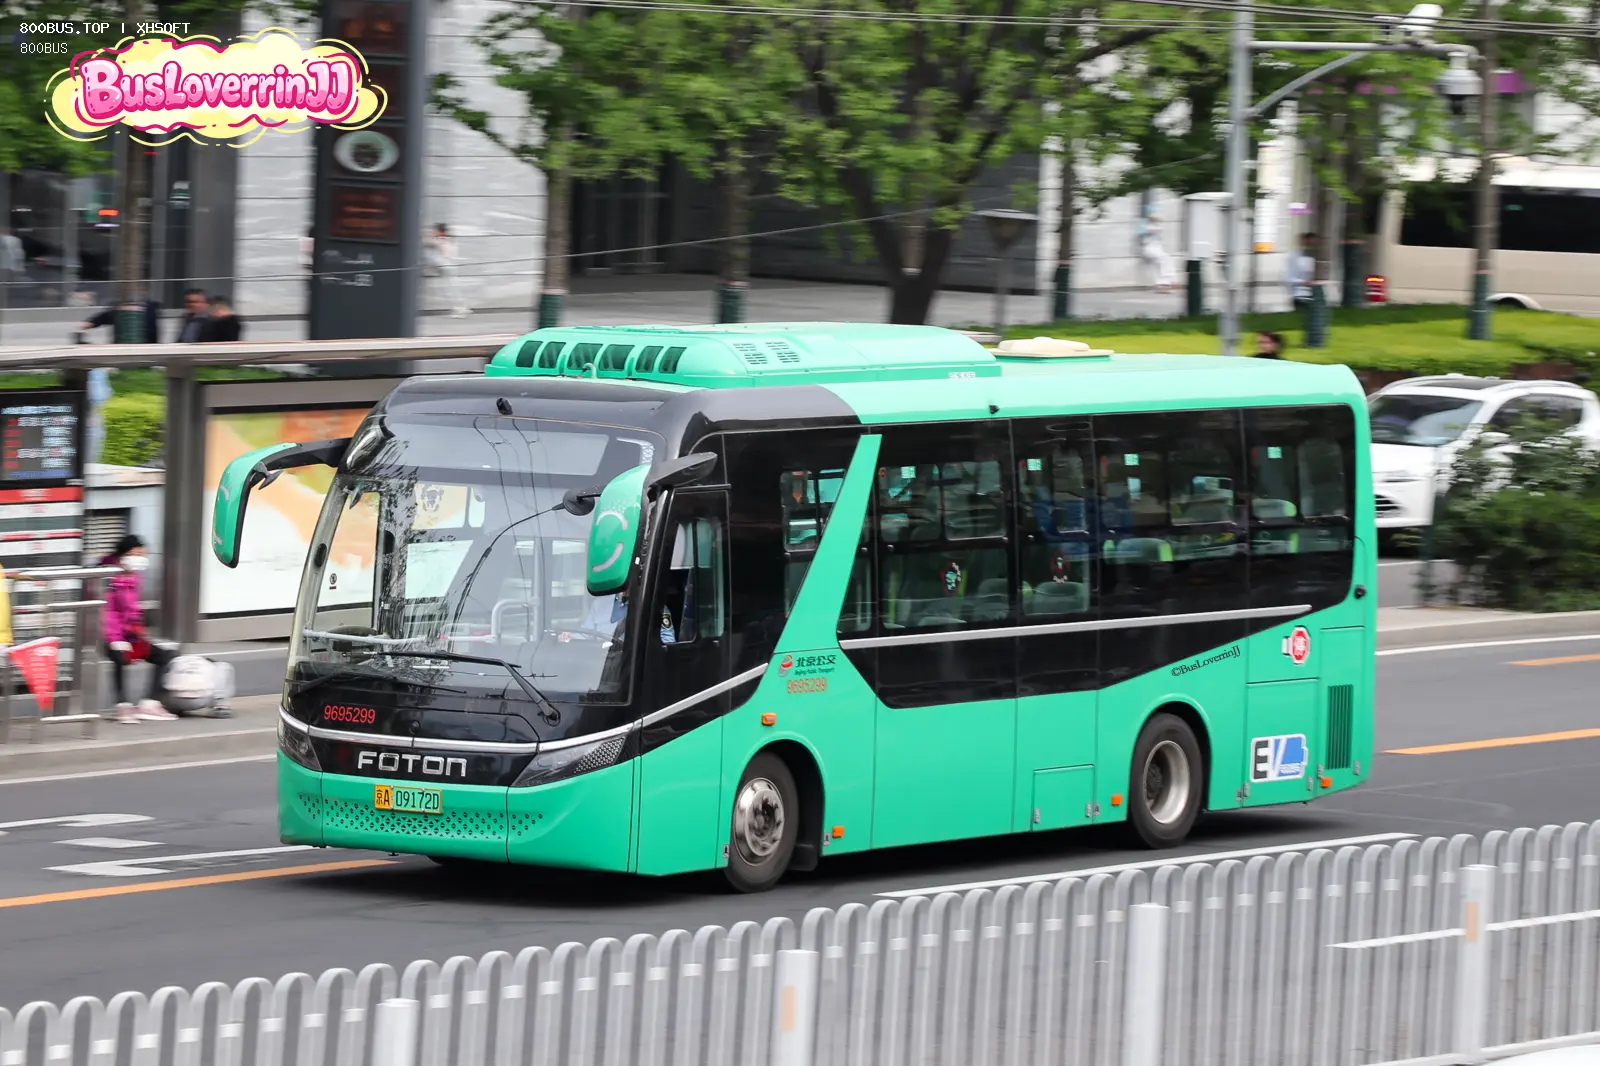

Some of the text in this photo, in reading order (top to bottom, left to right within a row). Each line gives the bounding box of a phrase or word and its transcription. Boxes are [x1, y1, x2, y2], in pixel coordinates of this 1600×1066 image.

[795, 654, 836, 667] 北京公交
[787, 678, 827, 694] 9695299
[324, 705, 376, 724] 9695299
[357, 751, 467, 776] FOTON
